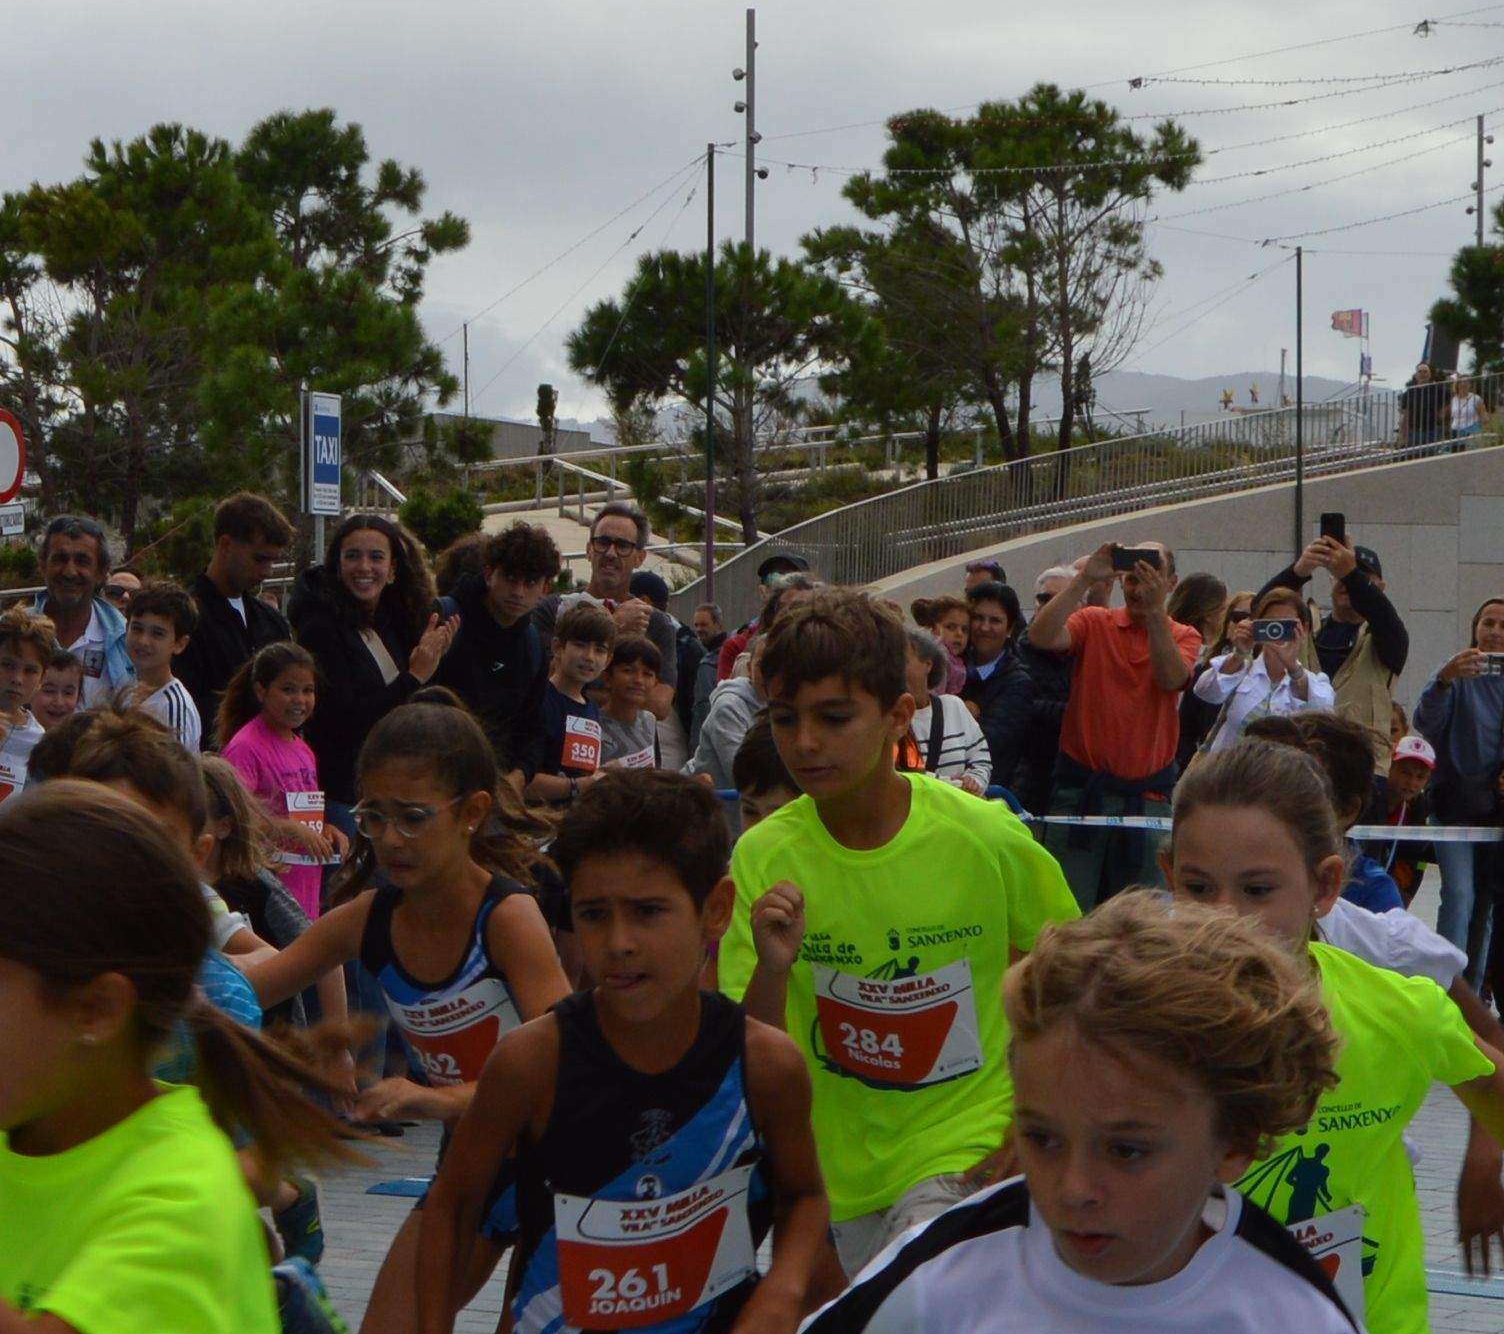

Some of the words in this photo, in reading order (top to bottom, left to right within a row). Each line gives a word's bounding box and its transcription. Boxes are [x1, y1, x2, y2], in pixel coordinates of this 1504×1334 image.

[314, 435, 339, 466] TAXI
[572, 742, 595, 759] 350
[908, 924, 983, 949] SANXENXO
[858, 979, 888, 995] XXV
[893, 977, 937, 994] MILLA
[888, 983, 951, 1004] SANXENXO
[839, 1022, 905, 1058] 284
[620, 1207, 660, 1222] XXV
[664, 1186, 711, 1215] MILLA
[588, 1263, 670, 1300] 261
